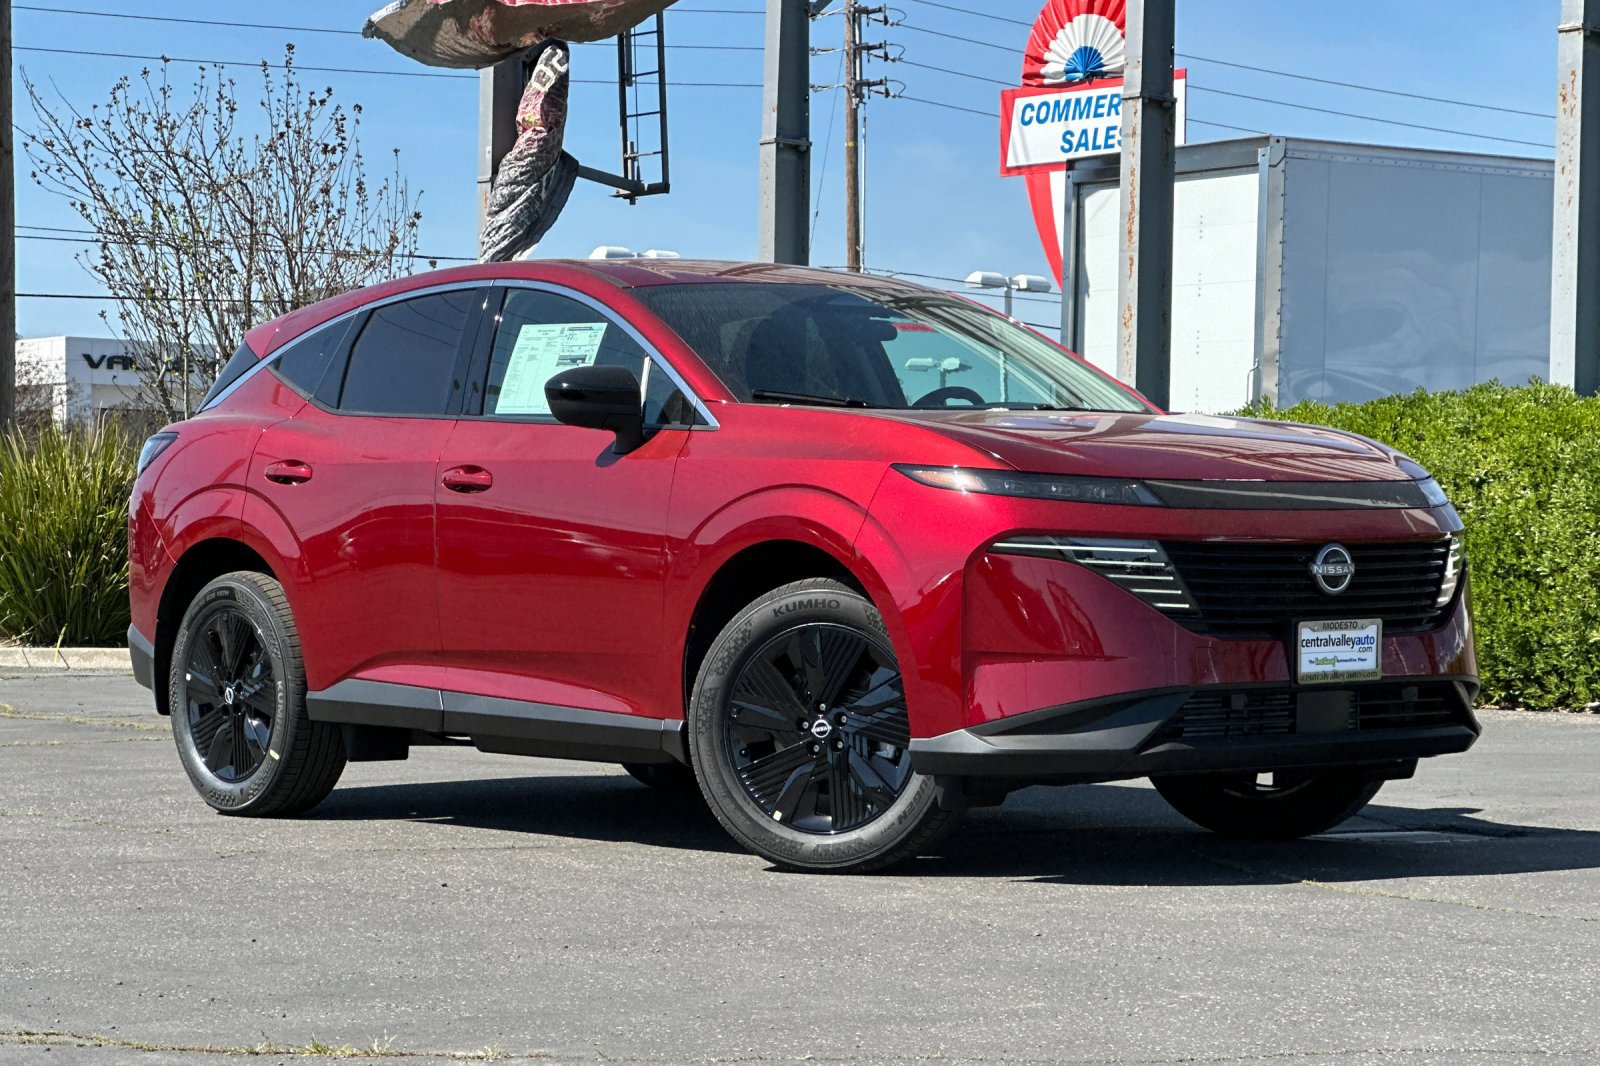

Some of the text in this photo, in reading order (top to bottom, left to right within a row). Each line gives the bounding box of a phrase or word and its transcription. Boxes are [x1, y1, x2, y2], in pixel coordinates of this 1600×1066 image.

[1312, 565, 1355, 574] NISSAN
[773, 599, 840, 617] KUMHO
[1322, 621, 1358, 630] MODESTO
[1301, 634, 1375, 649] centralvalleyauto
